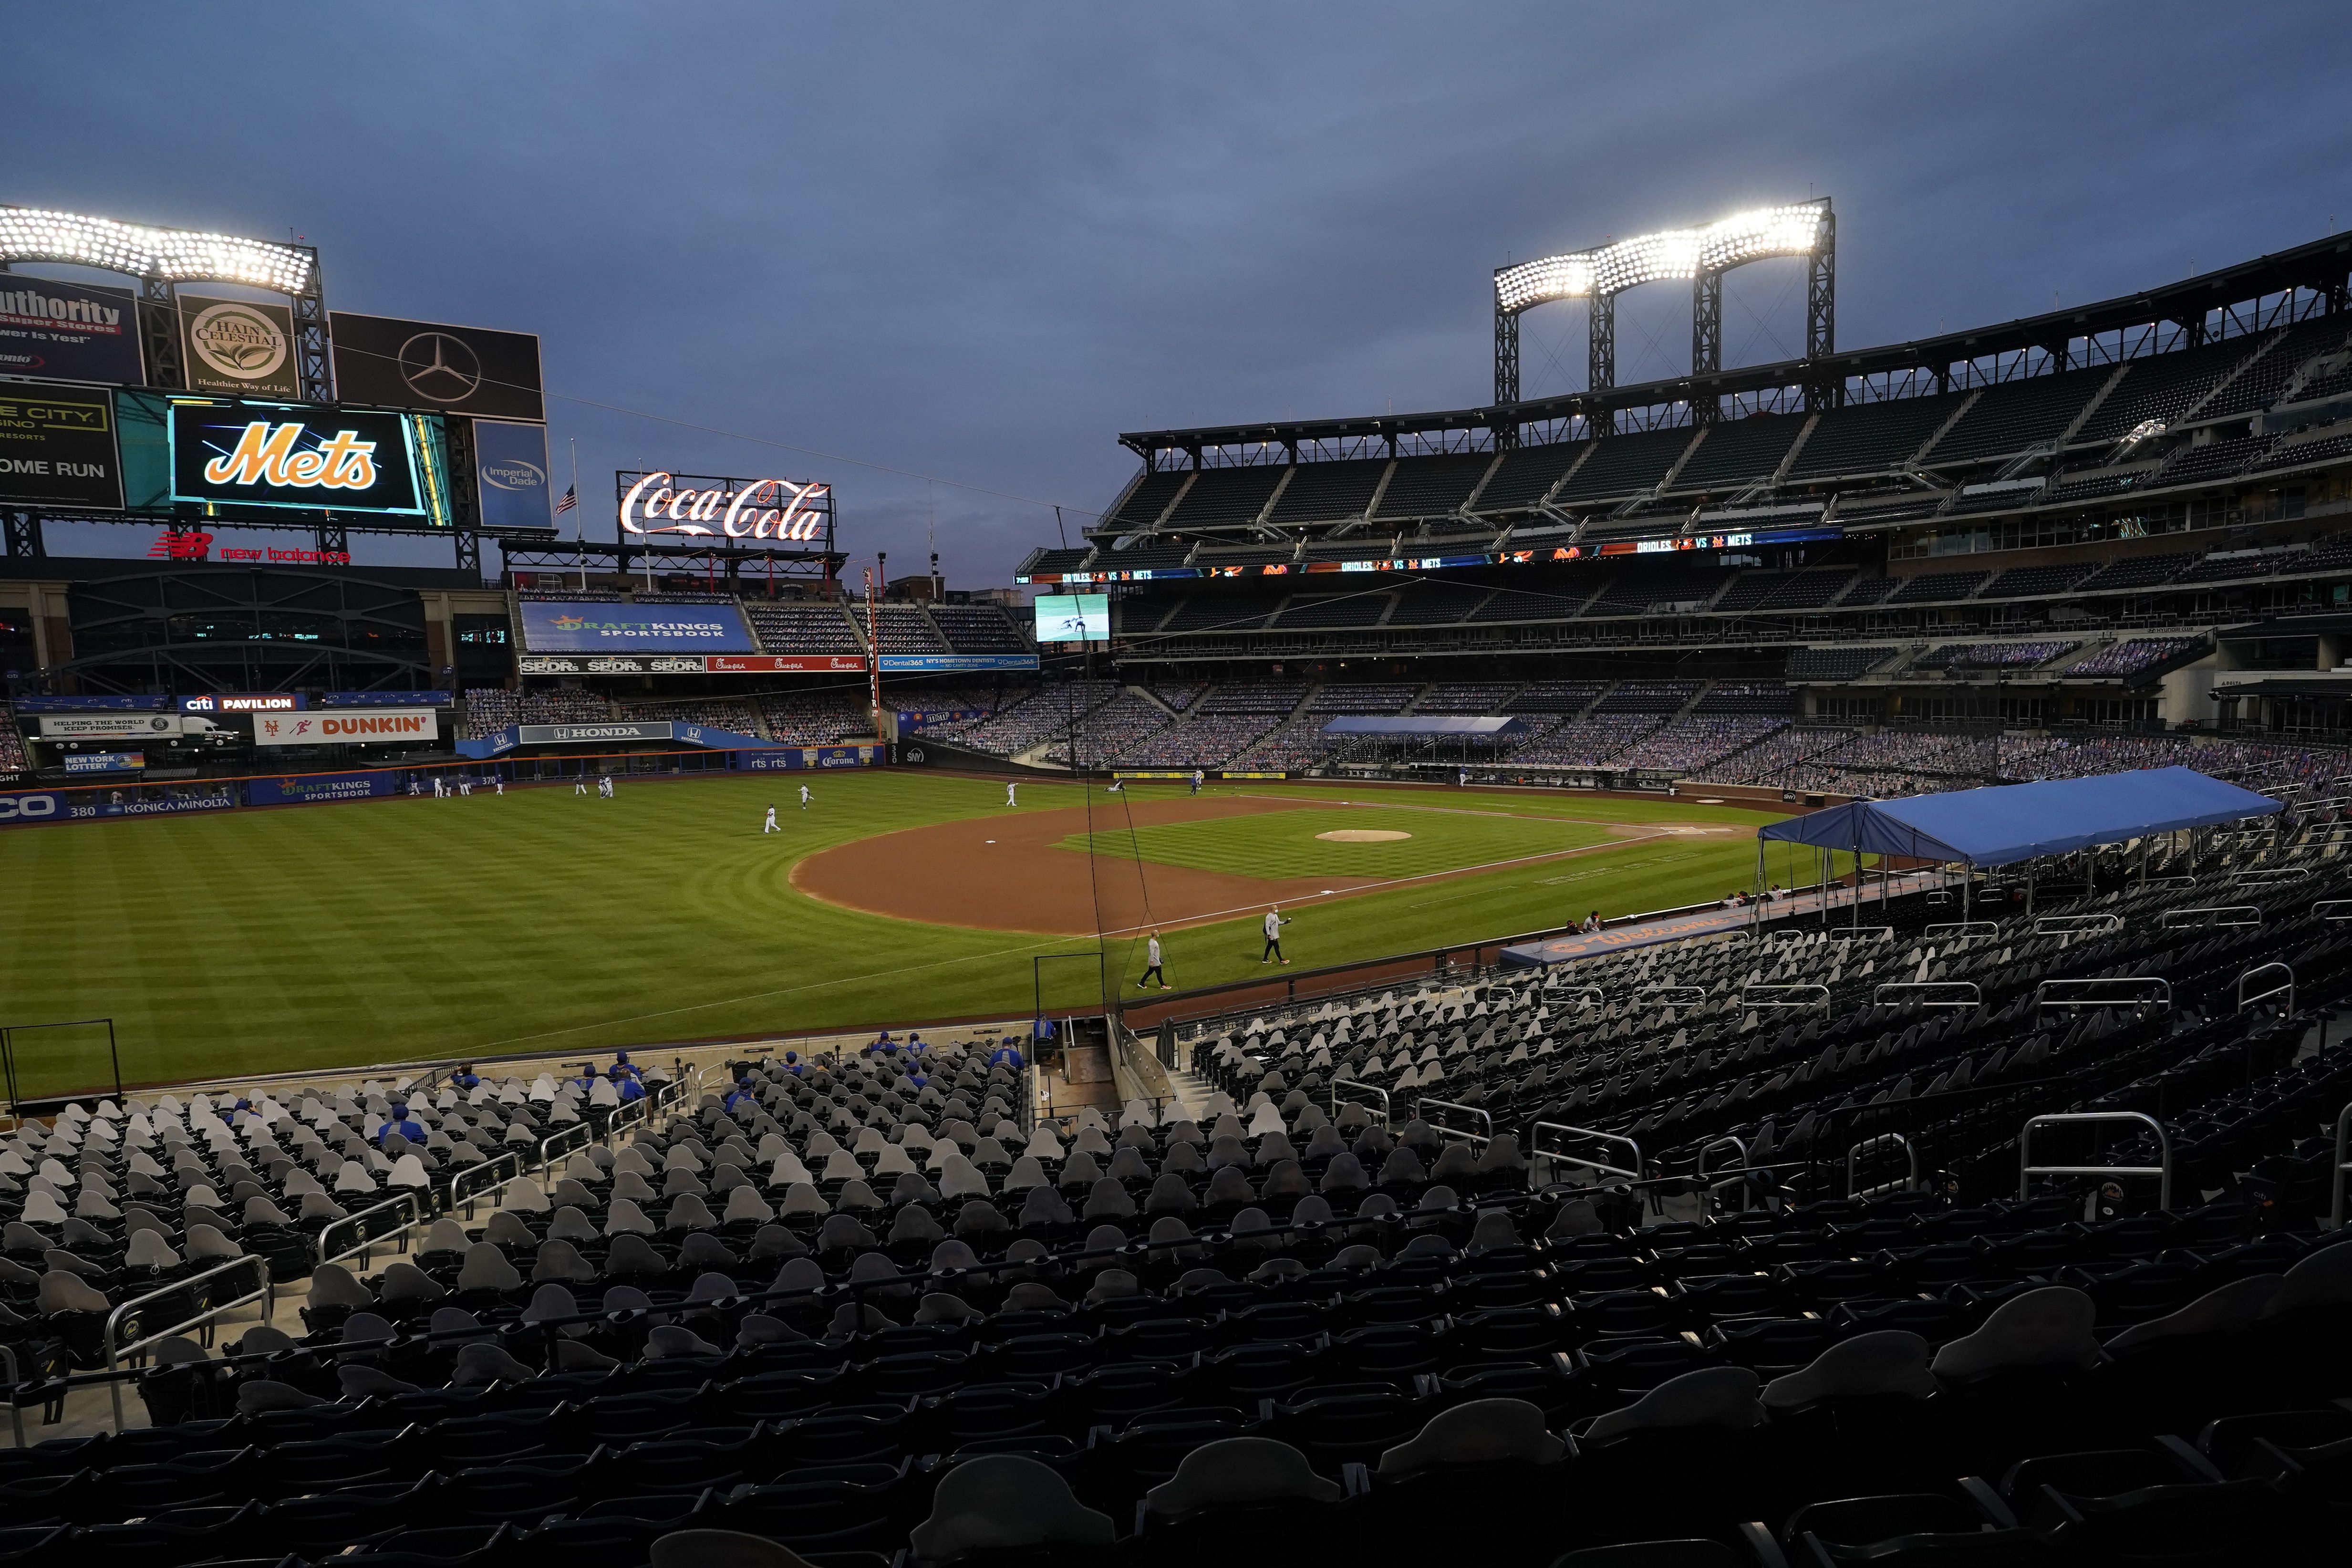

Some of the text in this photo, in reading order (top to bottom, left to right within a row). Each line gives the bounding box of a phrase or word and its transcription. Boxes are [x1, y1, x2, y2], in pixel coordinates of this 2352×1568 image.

[0, 315, 116, 332] Super Stores
[217, 322, 259, 335] HAIN
[32, 331, 47, 340] Is
[196, 328, 281, 346] CELESTIAL
[197, 378, 239, 389] Healthier
[241, 382, 260, 391] Way
[273, 384, 290, 393] Life
[27, 407, 93, 422] CITY
[0, 433, 45, 441] RESORTS
[205, 421, 376, 490] Mets
[0, 459, 104, 478] OME RUN
[489, 467, 532, 479] Imperial
[509, 474, 537, 487] Dade
[620, 472, 829, 541] Coca-Cola
[1637, 540, 1671, 553] ORIOLES
[1696, 538, 1707, 548] VS
[1728, 534, 1752, 546] METS
[220, 547, 351, 563] new balance
[1341, 561, 1372, 571] ORIOLES
[1394, 561, 1404, 569] VS
[1422, 558, 1440, 568] METS
[1108, 572, 1117, 581] VS
[1133, 571, 1152, 580] METS
[556, 622, 724, 631] DRAFTKINGS
[186, 696, 292, 710] citi PAVILION
[322, 717, 426, 735] DUNKIN'
[571, 727, 642, 737] HONDA
[681, 736, 704, 744] HONDA
[493, 742, 513, 752] HONDA
[752, 759, 767, 768] rts
[771, 758, 786, 768] rts
[822, 757, 854, 768] Corona
[907, 752, 921, 762] SNY
[66, 763, 108, 771] LOTTERY
[482, 777, 496, 785] 370
[281, 780, 371, 796] DRAFTKINGS
[305, 789, 371, 800] SPORTSBOOK
[70, 807, 95, 817] 380
[124, 798, 230, 813] KONICA MINOLTA
[1585, 918, 1729, 945] Welcome
